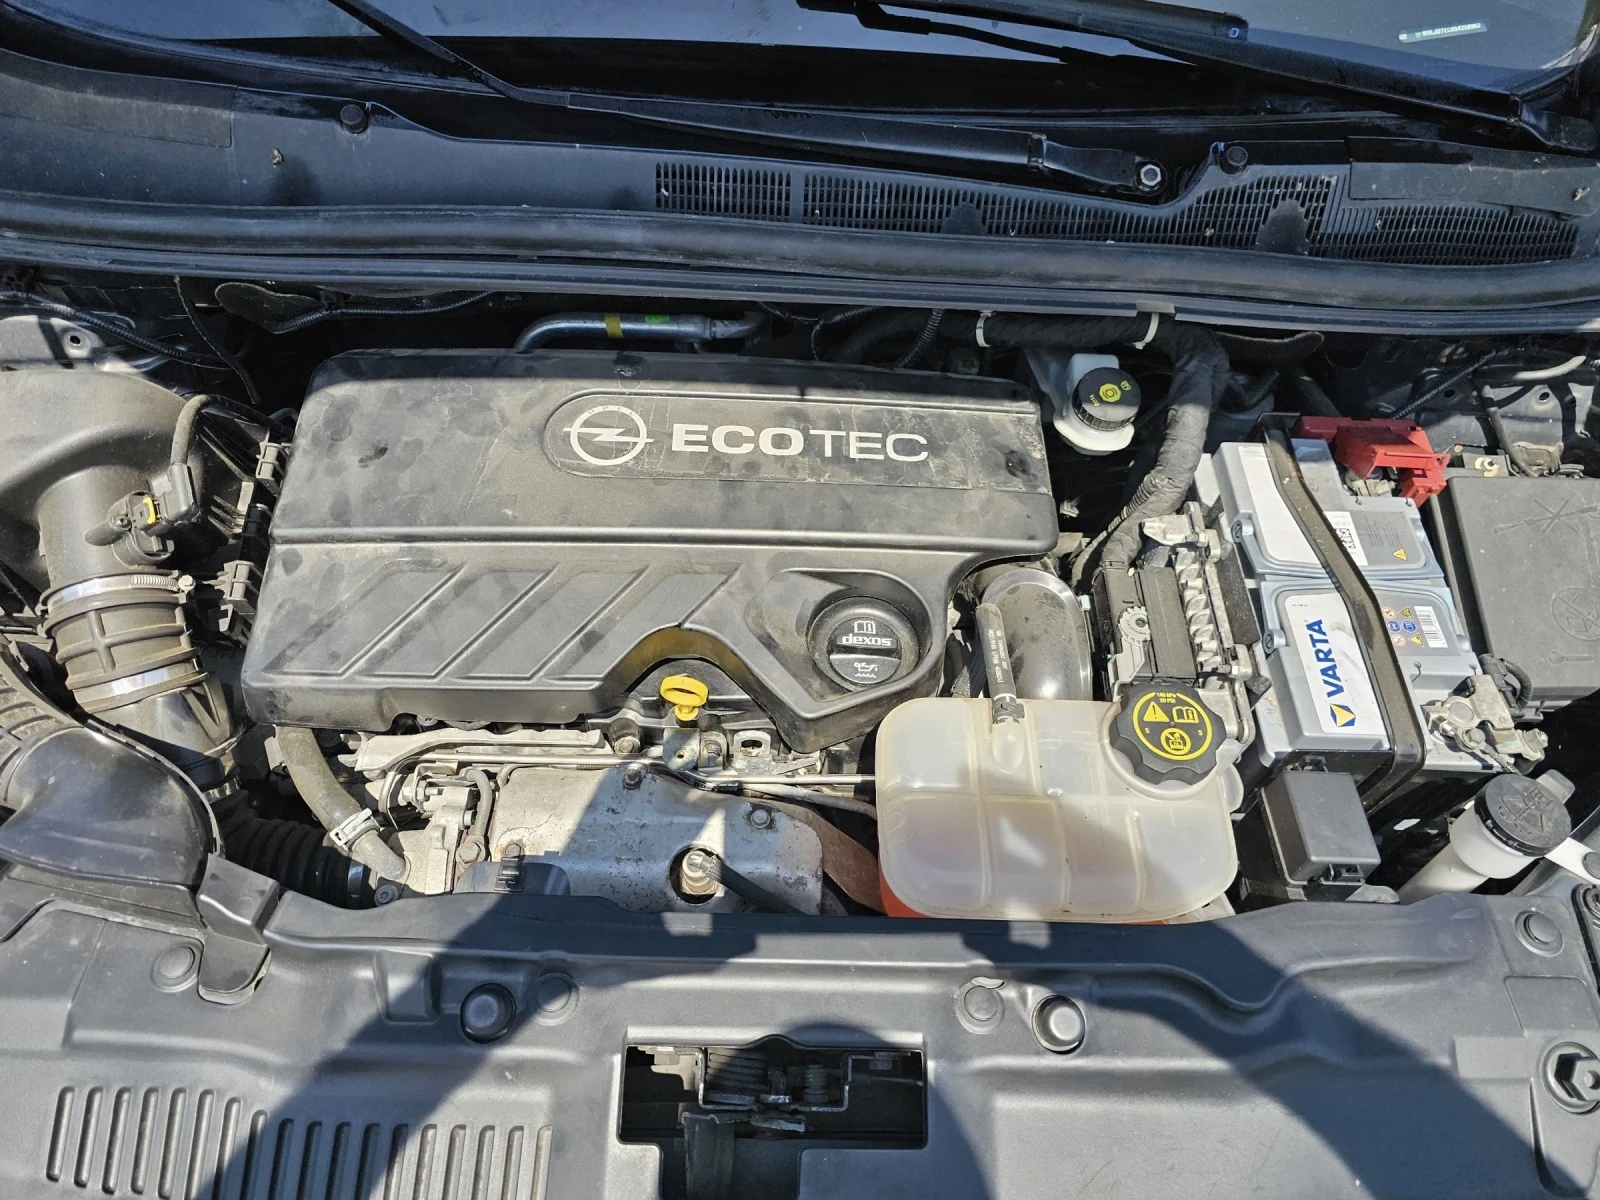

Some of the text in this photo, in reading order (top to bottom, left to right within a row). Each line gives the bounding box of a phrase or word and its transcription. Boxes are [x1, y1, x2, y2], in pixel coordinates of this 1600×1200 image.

[672, 423, 929, 462] ECOTEC
[842, 633, 893, 646] dexos
[1305, 619, 1345, 698] VARTA
